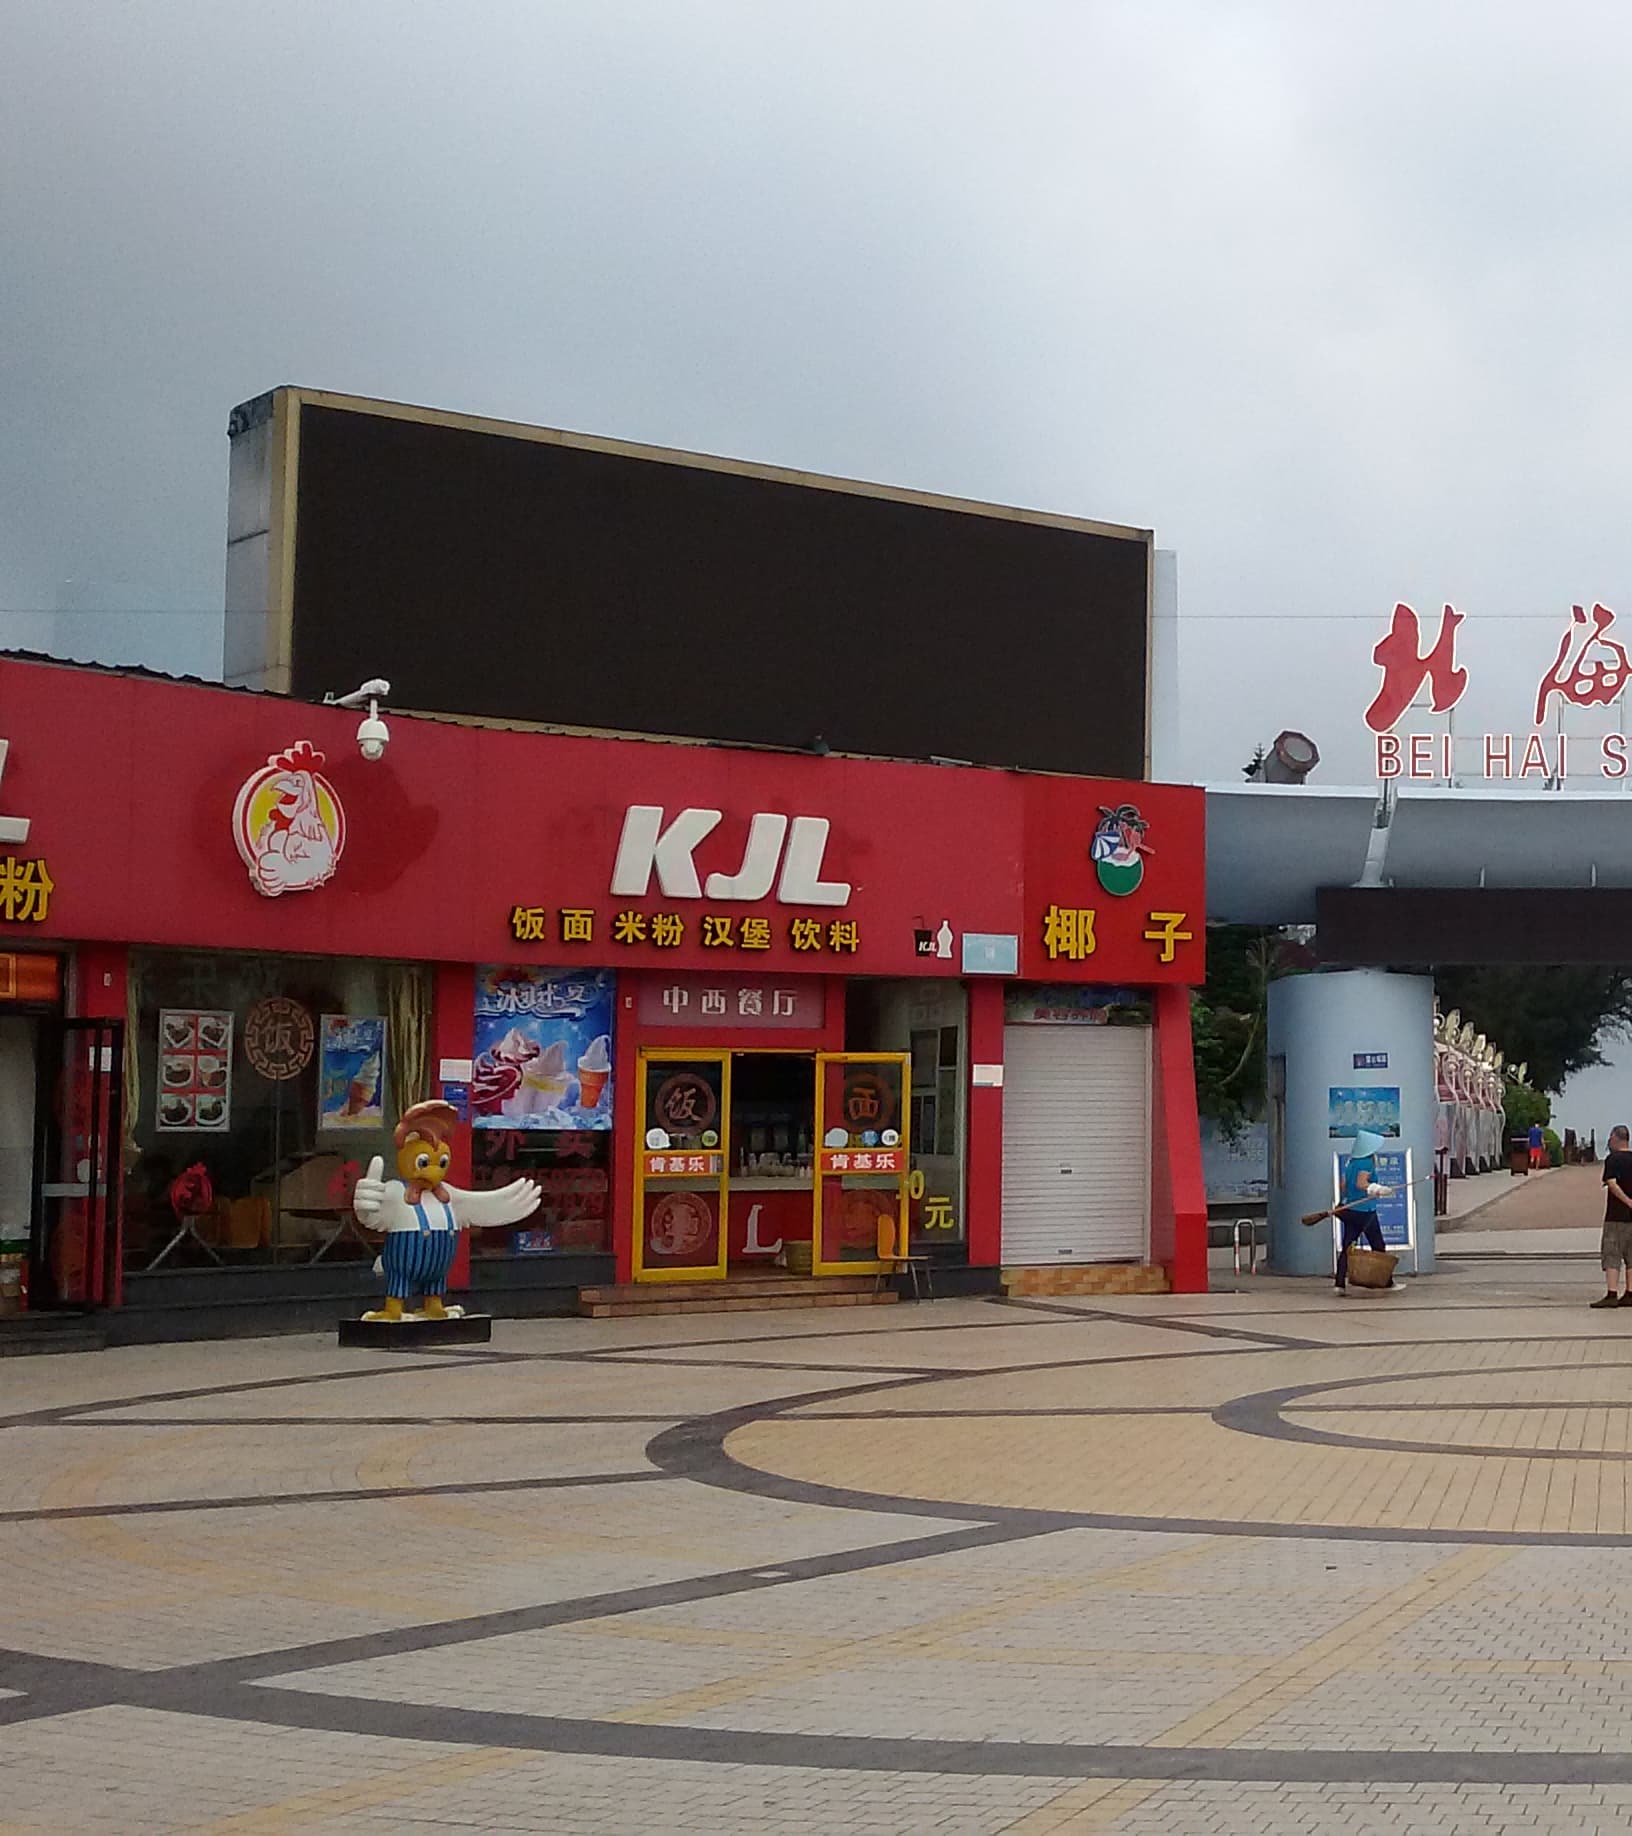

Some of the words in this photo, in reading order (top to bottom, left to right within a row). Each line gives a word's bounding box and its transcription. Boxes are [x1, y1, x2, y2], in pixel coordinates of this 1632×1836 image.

[1375, 732, 1454, 779] BEI
[1482, 732, 1569, 779] HAI
[610, 805, 851, 906] KJL
[0, 856, 55, 922] 粉
[1043, 904, 1193, 962] 椰子
[663, 985, 798, 1016] 中西餐厅
[650, 1157, 705, 1173] 肯基乐
[830, 1153, 896, 1169] 肯基乐
